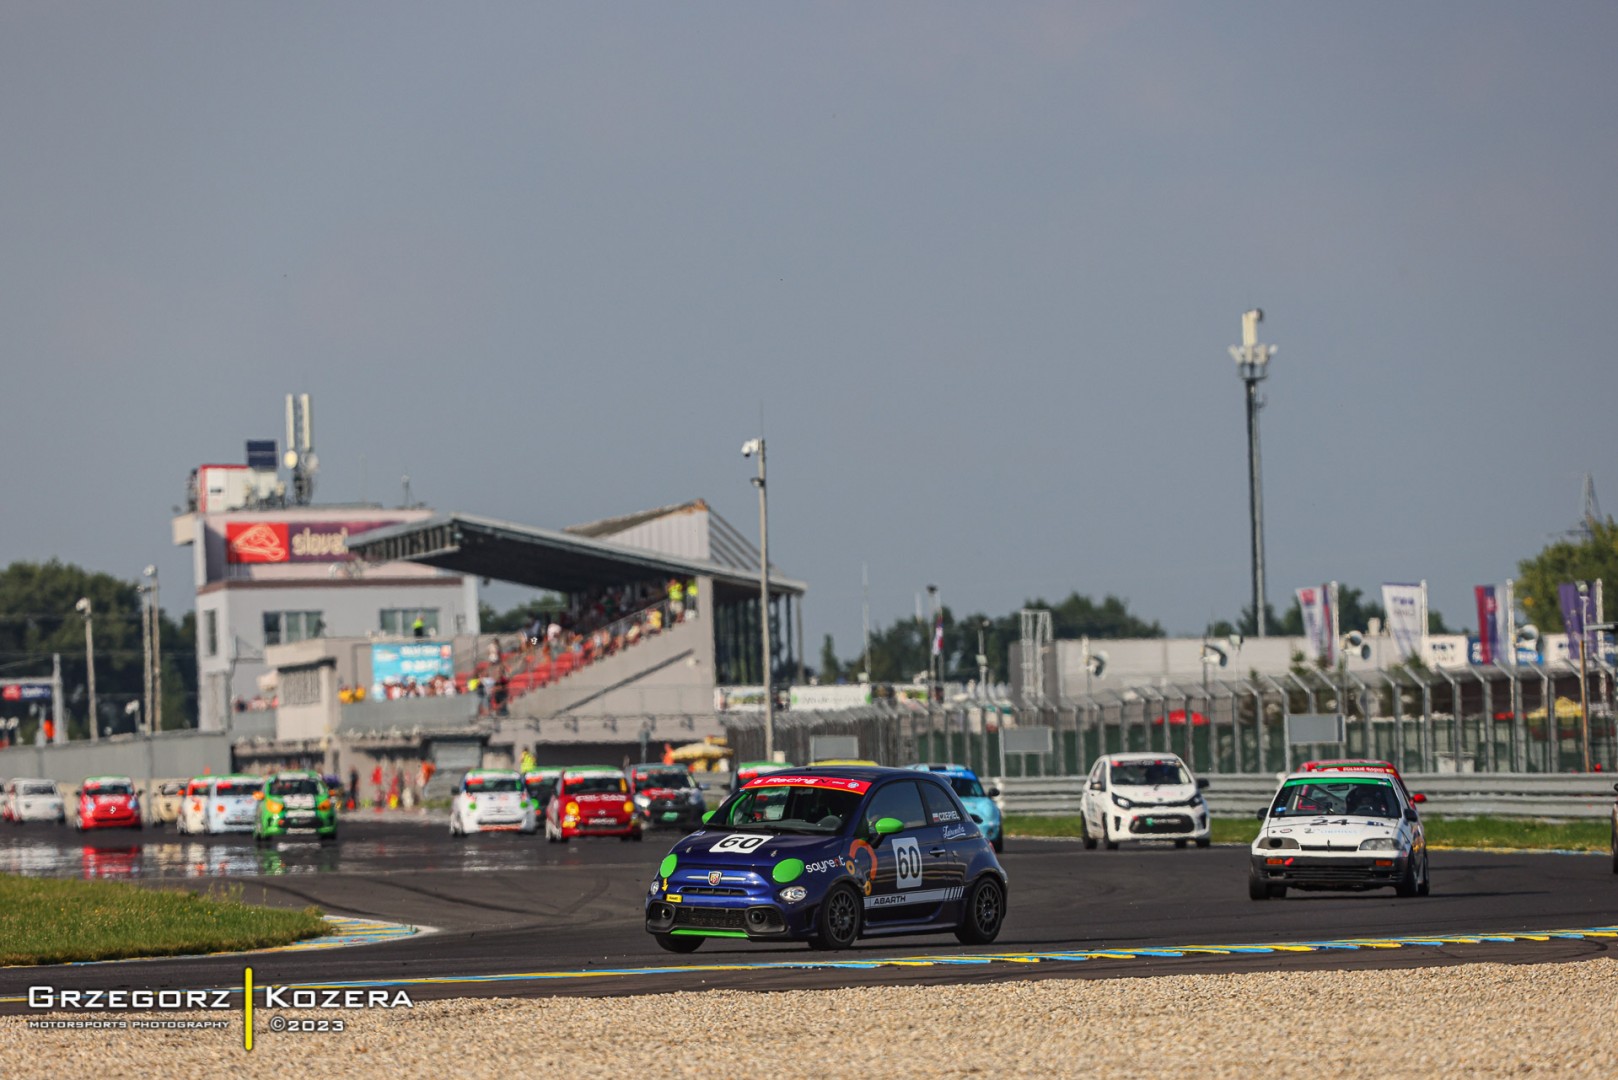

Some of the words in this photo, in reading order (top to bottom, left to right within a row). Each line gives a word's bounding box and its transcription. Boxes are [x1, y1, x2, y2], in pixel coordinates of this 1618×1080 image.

[1310, 818, 1350, 826] 24
[718, 836, 764, 849] 60
[805, 855, 846, 873] sayrent
[896, 845, 920, 880] 60
[873, 895, 906, 906] ABARTH
